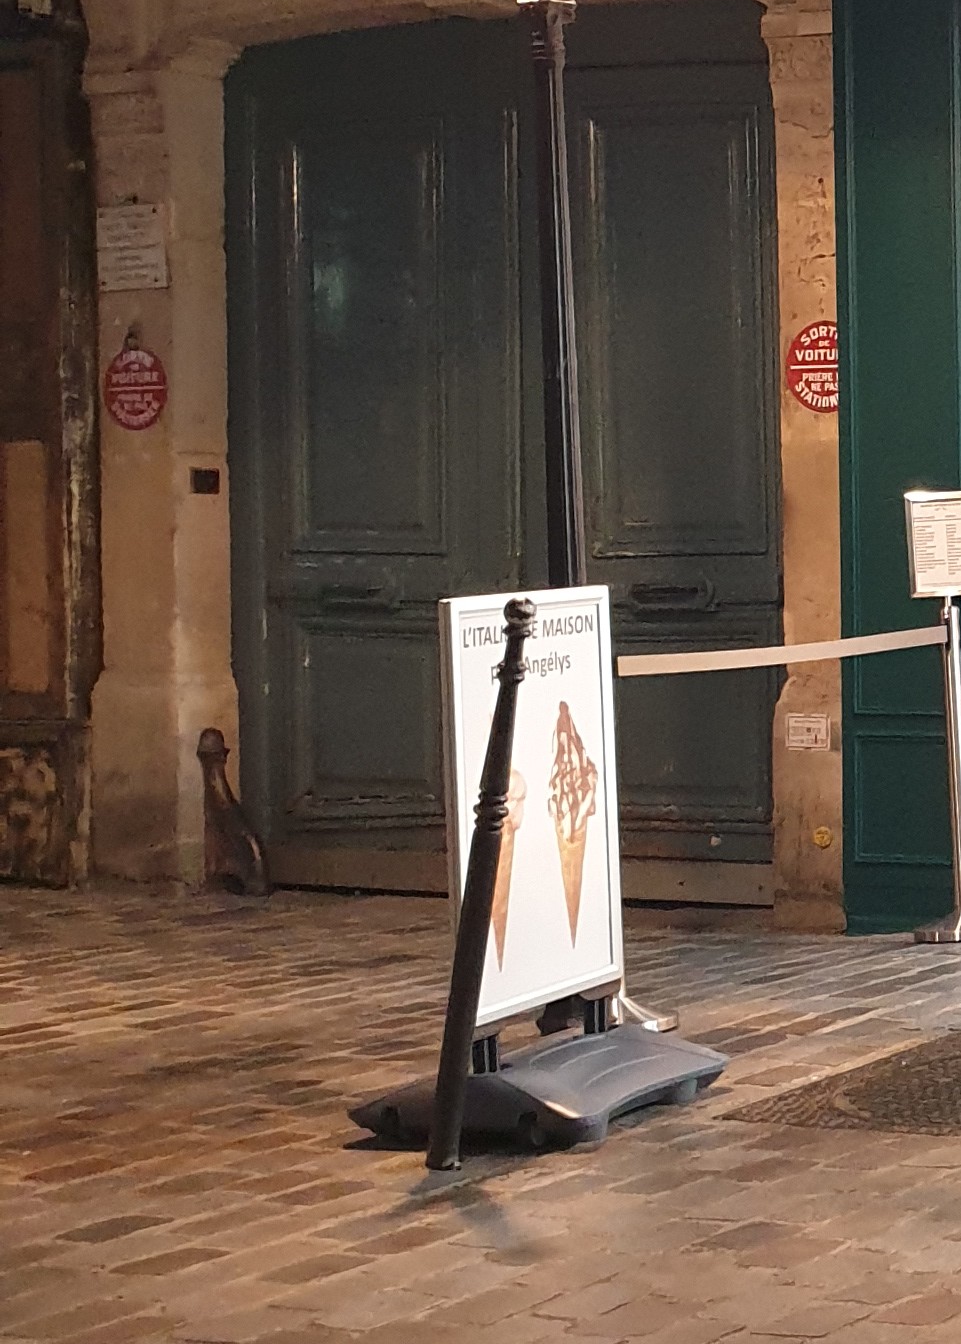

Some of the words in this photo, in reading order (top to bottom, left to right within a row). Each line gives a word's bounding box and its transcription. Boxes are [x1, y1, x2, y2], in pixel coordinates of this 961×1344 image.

[800, 325, 838, 346] SORT
[795, 349, 838, 361] VOITU
[795, 381, 838, 408] STATION
[463, 620, 538, 648] L'ITALIE
[542, 614, 594, 640] MAISON
[522, 651, 571, 677] Angélys
